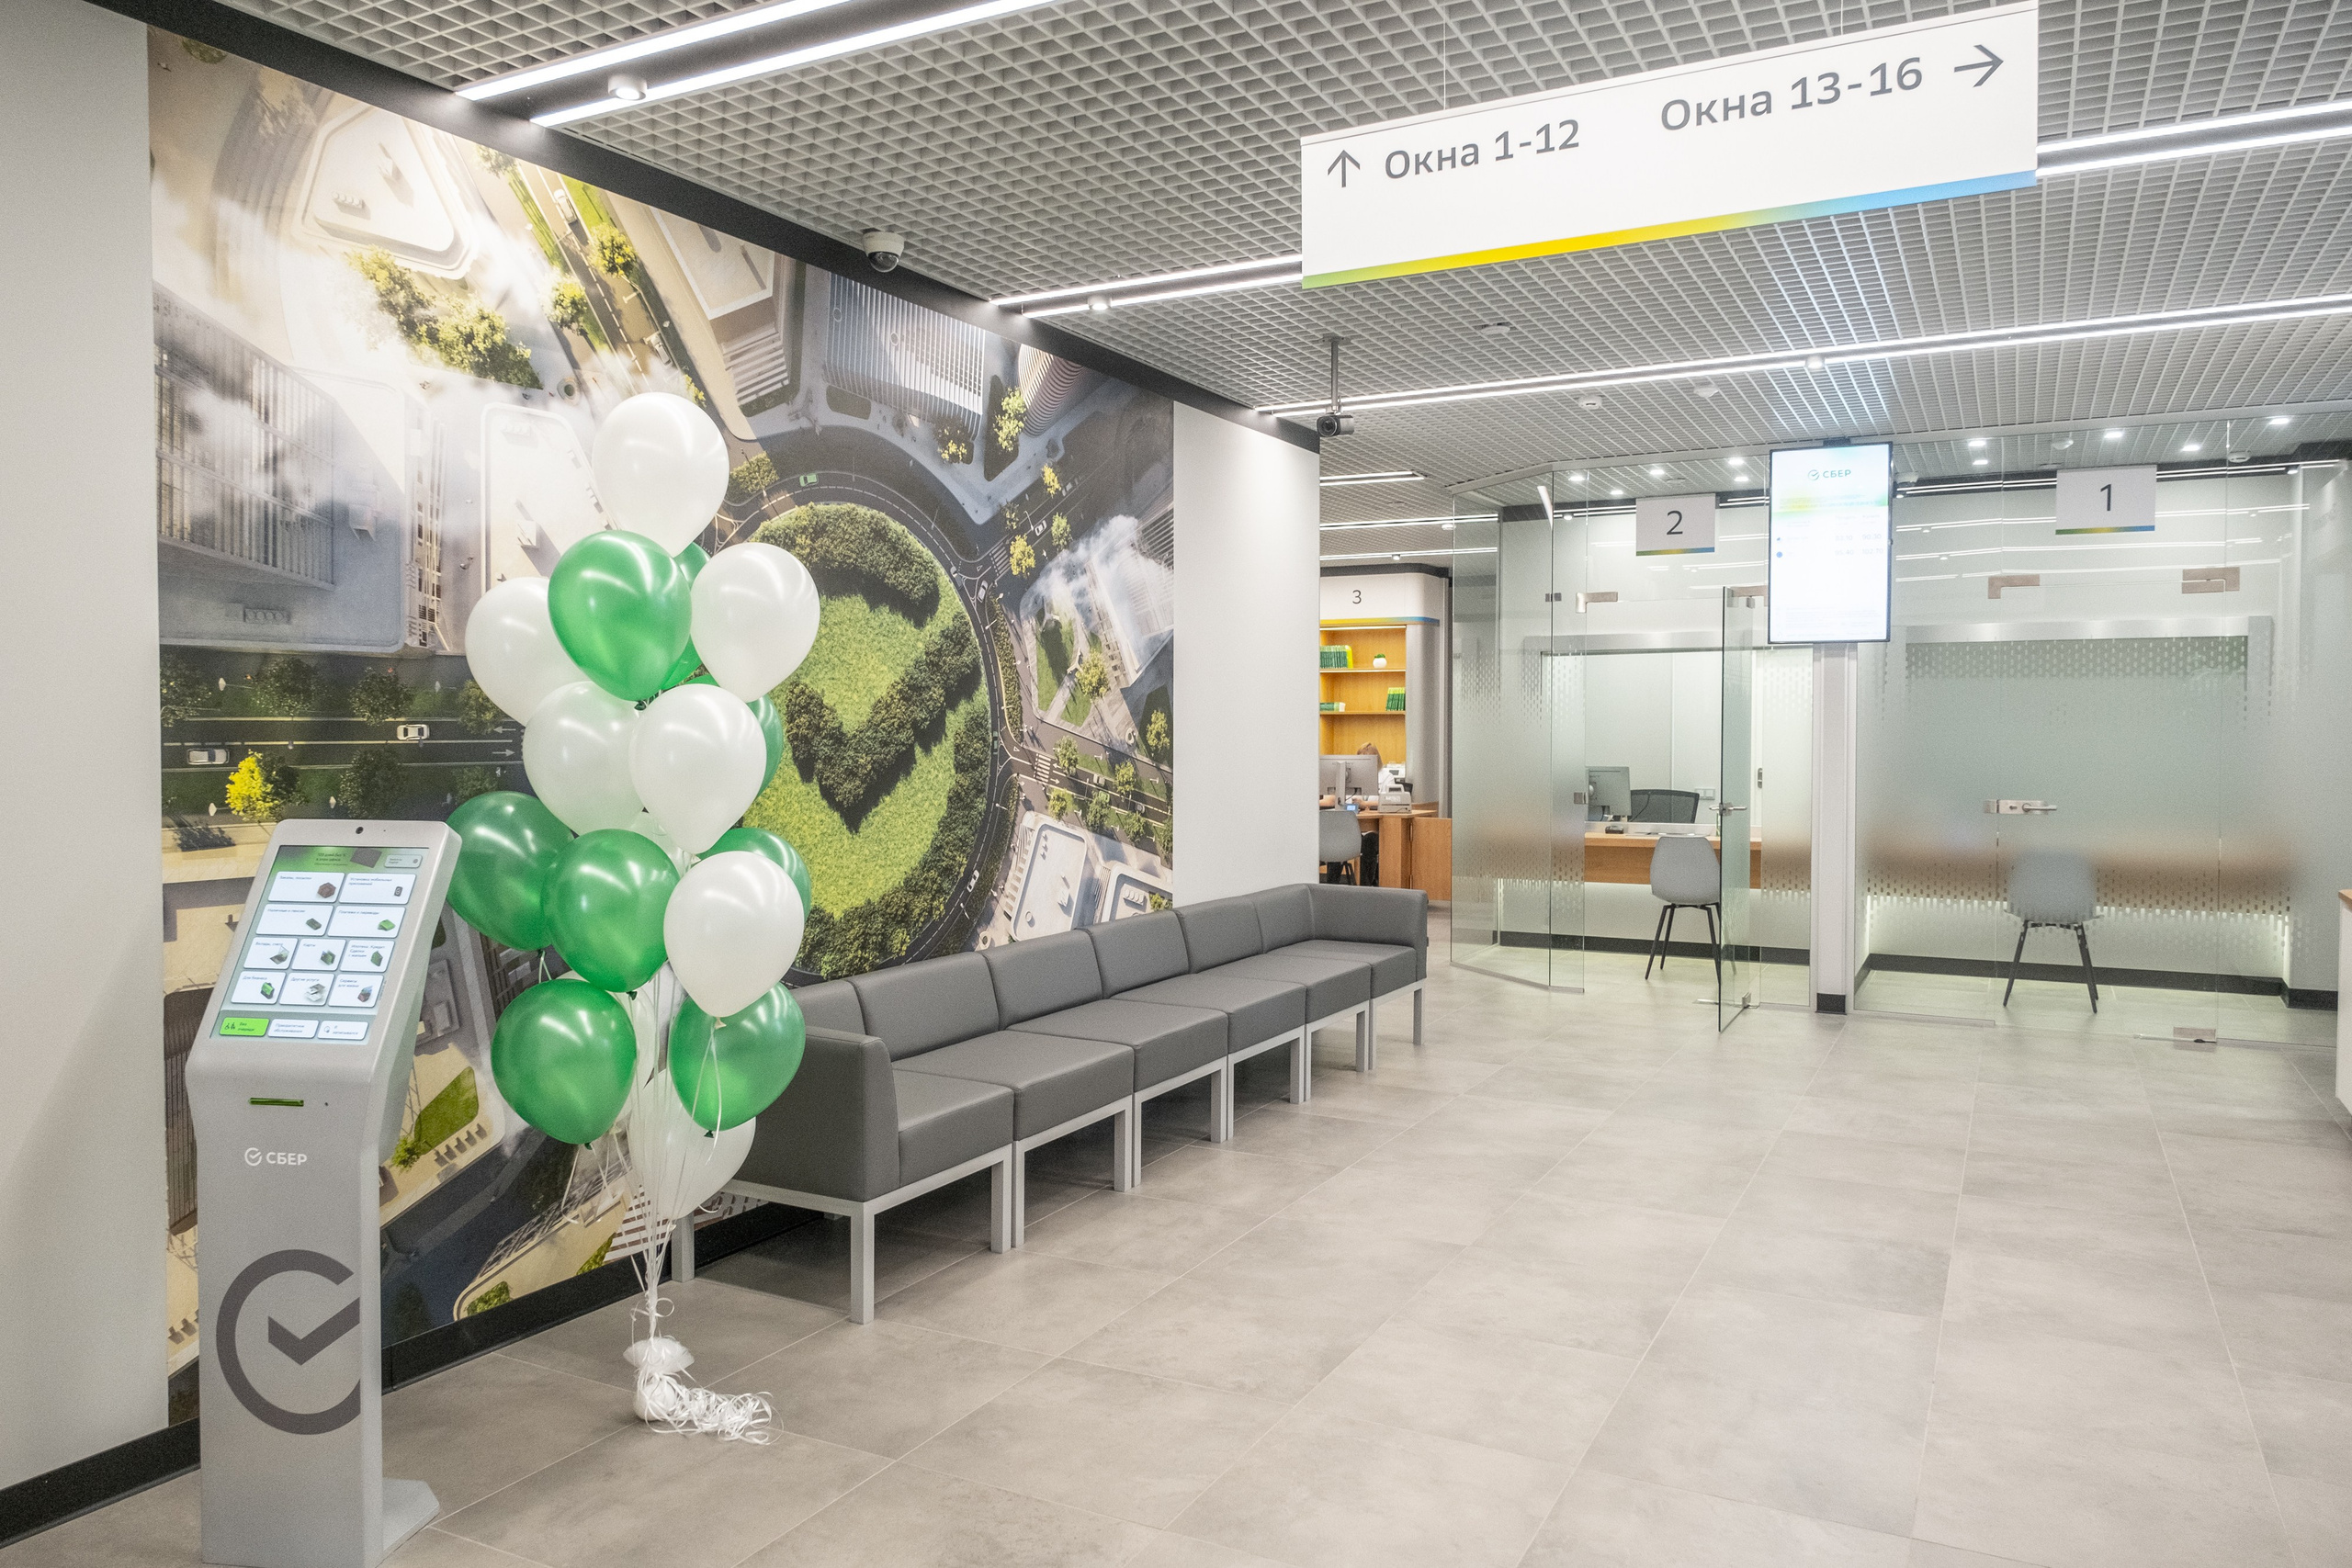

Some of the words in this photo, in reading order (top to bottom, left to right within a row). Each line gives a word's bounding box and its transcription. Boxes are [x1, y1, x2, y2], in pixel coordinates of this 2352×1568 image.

[1660, 90, 1772, 130] Окна
[1791, 57, 1923, 110] 13-16
[1385, 150, 1479, 179] Окна
[1495, 119, 1579, 162] 1-12
[1823, 468, 1852, 479] СБЕР
[2100, 483, 2112, 512] 1
[1666, 510, 1685, 536] 2
[1351, 589, 1363, 605] 3
[266, 1151, 308, 1166] СБЕР
